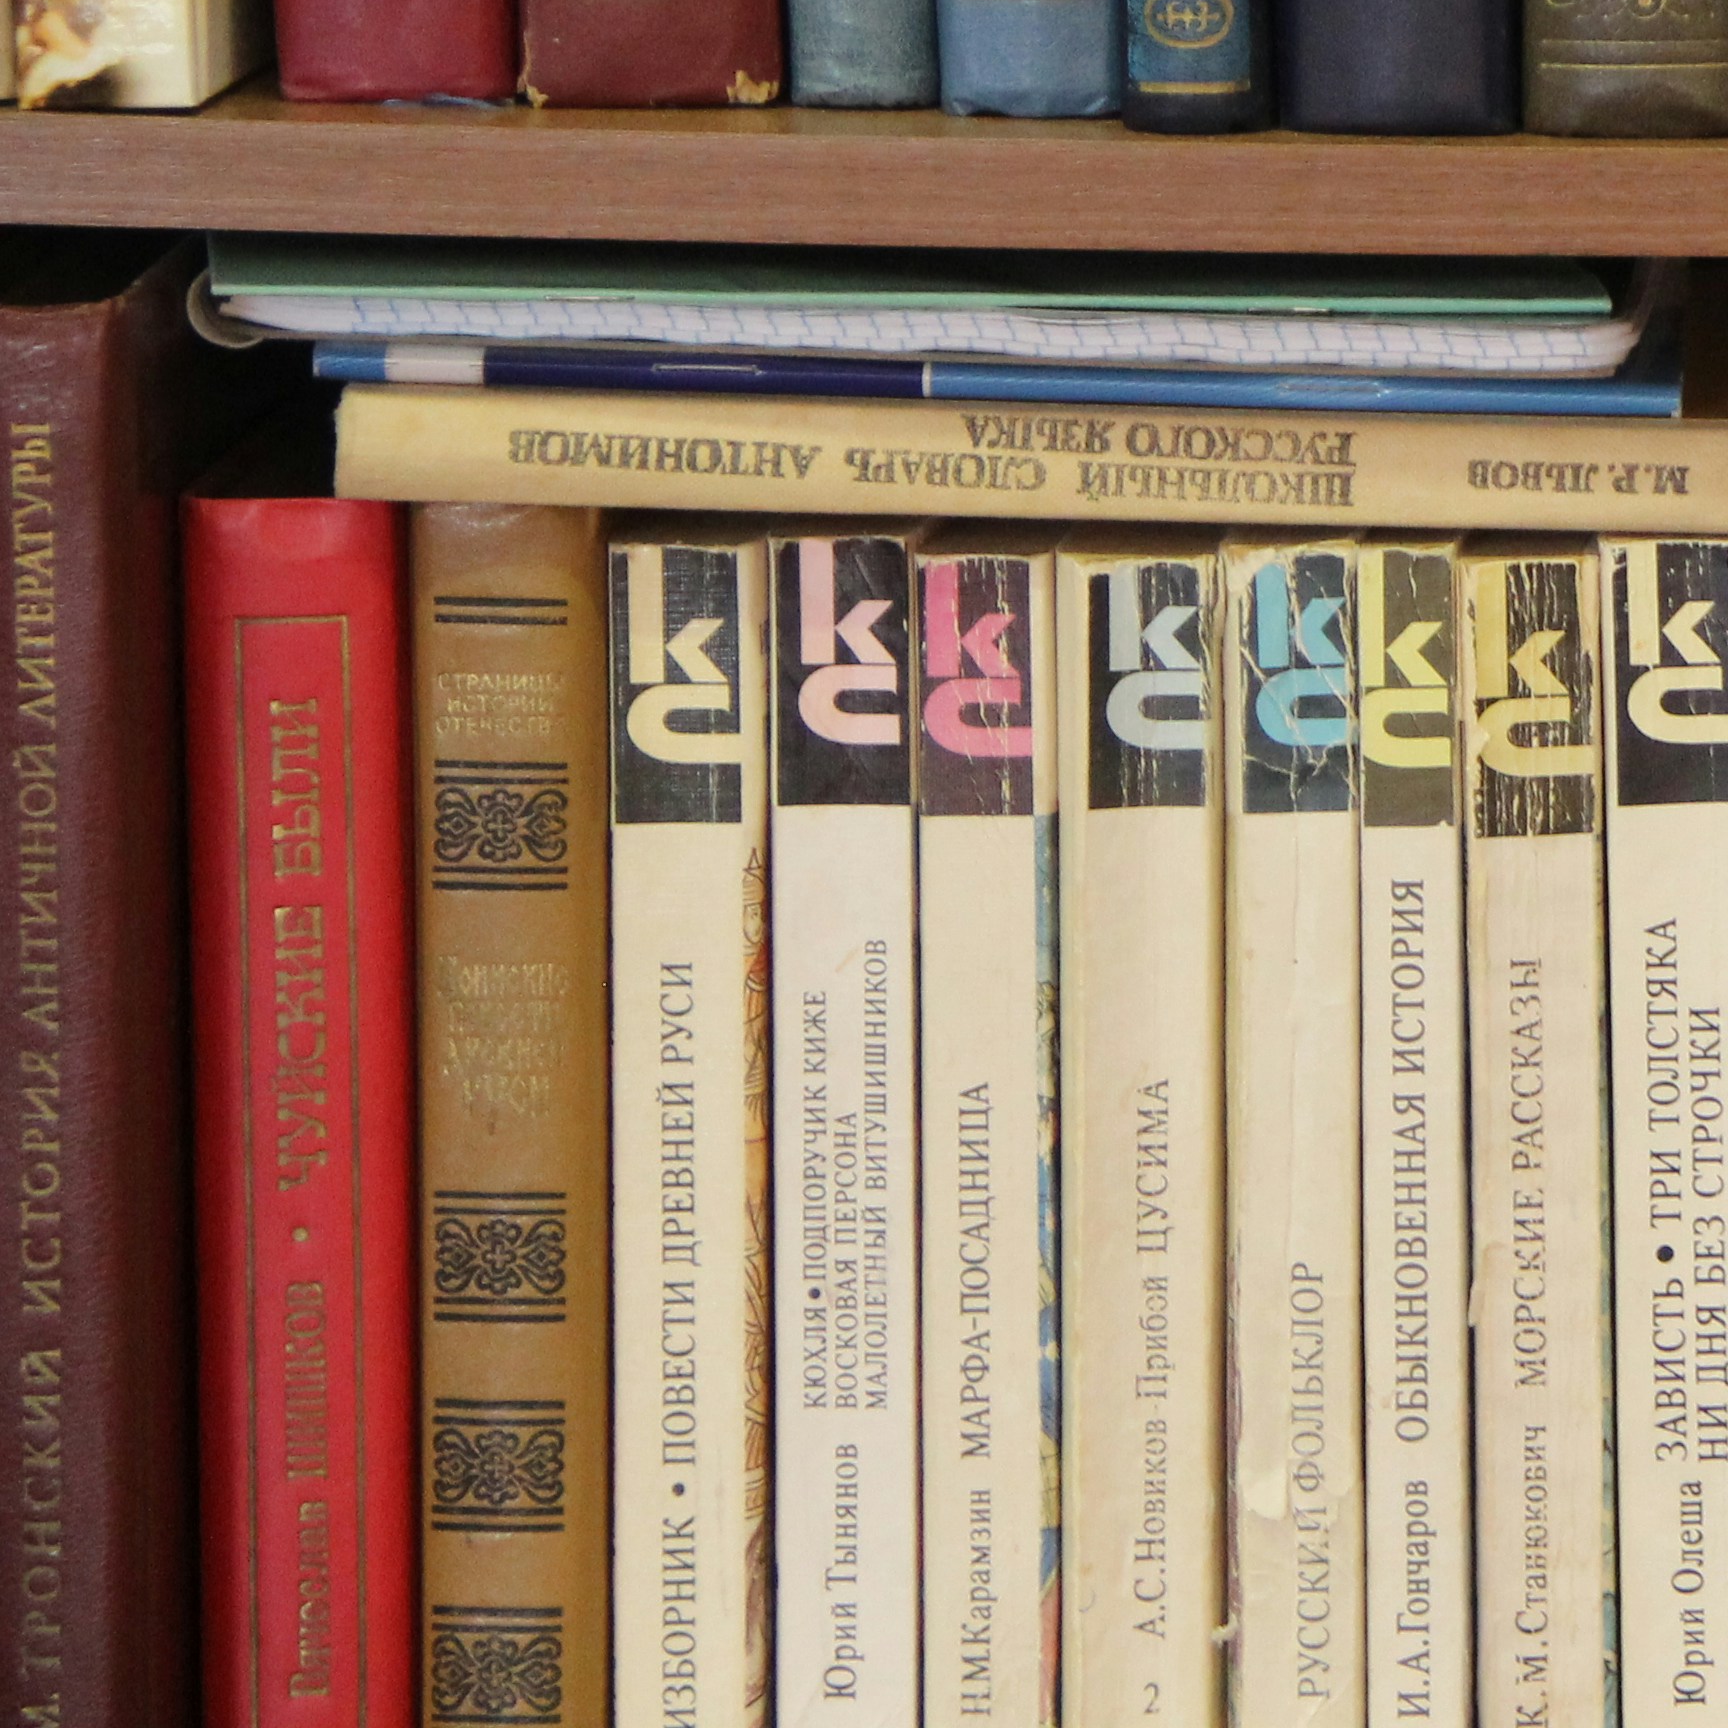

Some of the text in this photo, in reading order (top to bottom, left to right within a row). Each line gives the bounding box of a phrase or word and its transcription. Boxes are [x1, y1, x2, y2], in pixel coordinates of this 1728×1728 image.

[507, 428, 1356, 508] ШКОЛЬНЫЙ СЛОВАРЬ АНТОНИМОВ
[960, 413, 1358, 468] РУССКОГО ЯЗЫКА
[1467, 459, 1599, 494] ЛЬВОВ
[9, 420, 62, 1675] ТРОНСКИЙ ИСТОРИЯ АНТИЧНОЙ ЛИТЕРАТУРЫ
[268, 698, 332, 1699] Вячеслав ШИШКОВ ЧУЙСКИЕ БЫЛИ
[802, 990, 834, 1410] КЮХЛЯ ПОДПОРУЧИК КИЖЕ
[859, 938, 889, 1410] МАЛОЛЕТНЫЙ ВИТУШИШНИКОВ
[1134, 1077, 1175, 1255] ЦУСИМА
[1389, 877, 1432, 1444] ОБЫКНОВЕННАЯ ИСТОРИЯ
[1508, 956, 1549, 1389] МОРСКИЕ РАССКАЗЫ
[1644, 916, 1688, 1463] ЗАВИСТЬ ТРИ ТОЛСТЯКА
[1687, 1005, 1725, 1200] СТРОЧКИ
[653, 961, 702, 1728] ИЗБОРНИК ПОВЕСТИ ДРЕВНЕЙ РУСИ
[834, 1110, 859, 1410] ВОСКОВАЯ ПЕРСОНА
[956, 1079, 998, 1460] МАРФА-ПОСАДНИЦА
[1690, 1212, 1728, 1288] БЕЗ
[822, 1442, 865, 1702] Юрий Тынянов
[1288, 1260, 1332, 1700] РУССКИЙ ФОЛЬКЛОР
[1670, 1479, 1716, 1708] Юрий Олеша
[1142, 1681, 1162, 1716] 2
